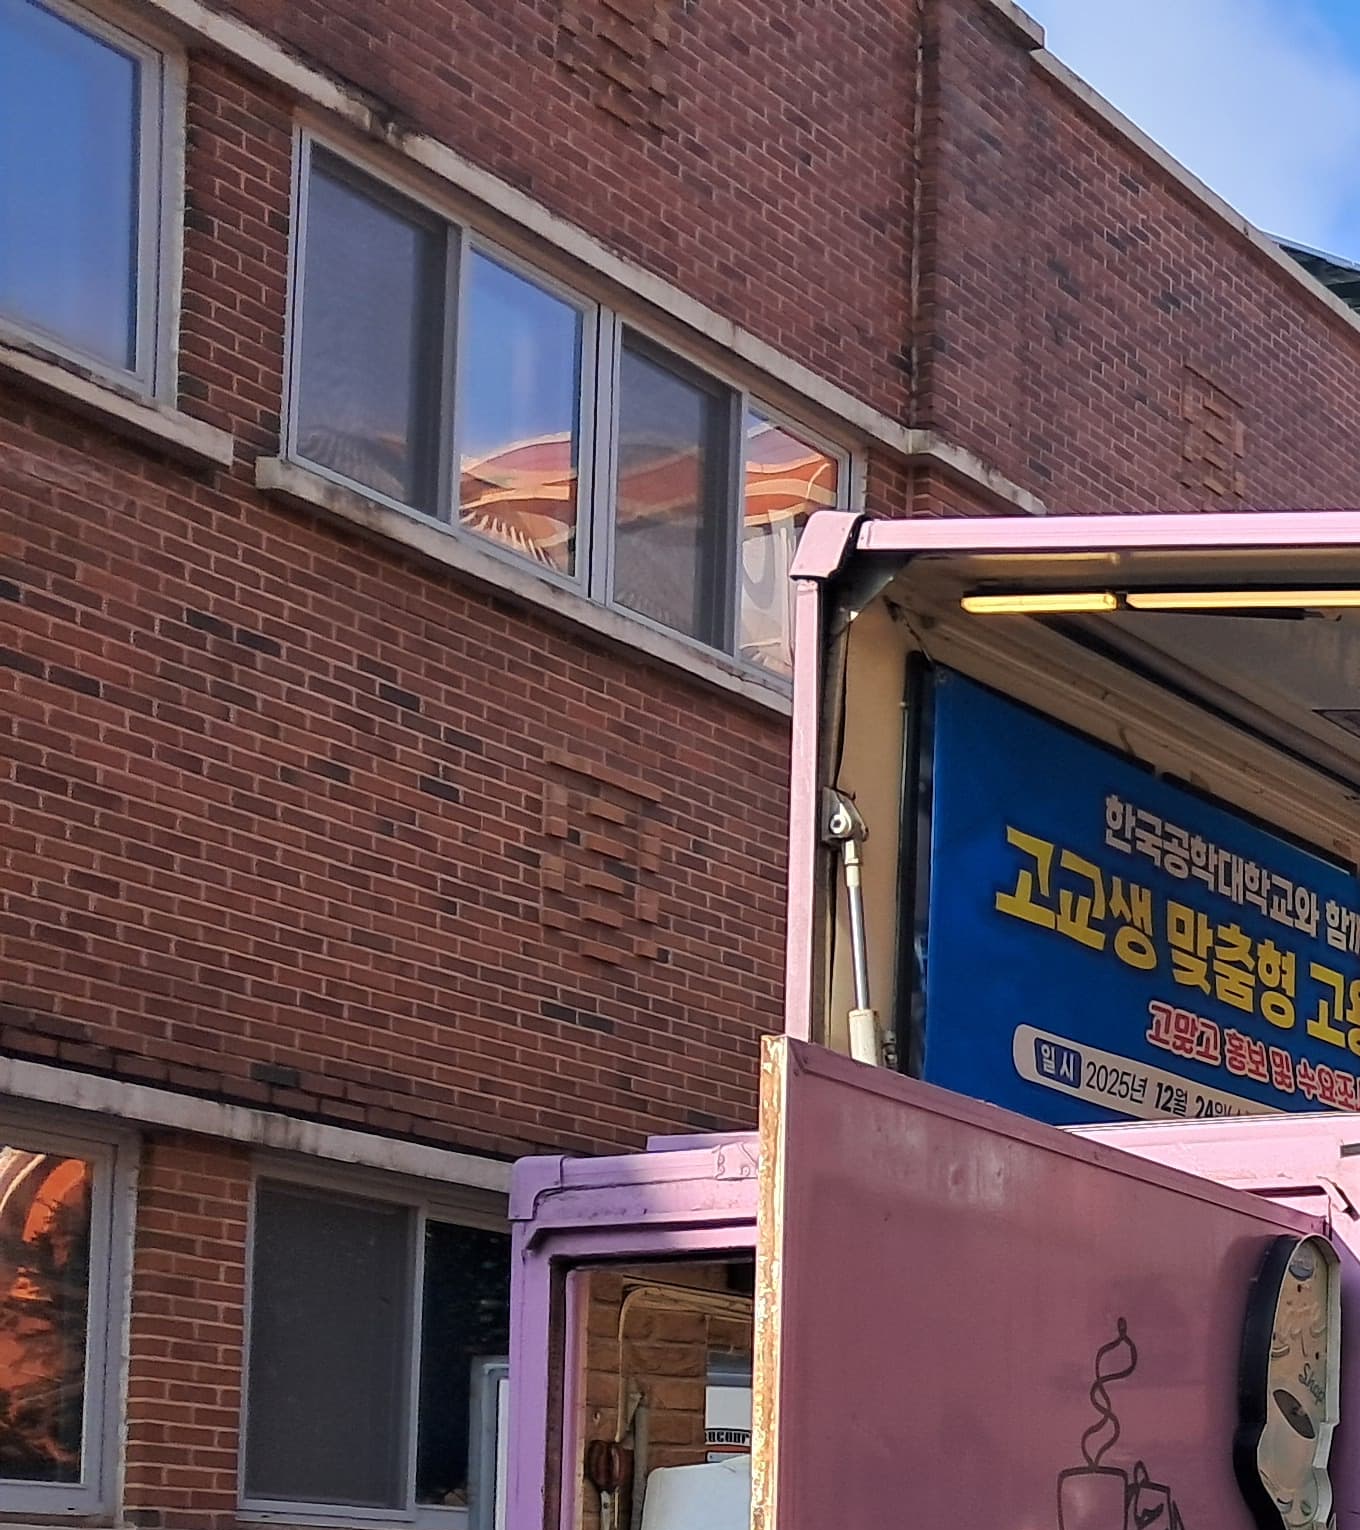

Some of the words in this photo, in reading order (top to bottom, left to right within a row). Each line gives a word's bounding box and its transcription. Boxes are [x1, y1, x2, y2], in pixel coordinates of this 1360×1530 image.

[1104, 794, 1320, 937] 한국공학대학교와
[994, 825, 1158, 970] 고교생
[1166, 901, 1297, 1031] 맞춤형
[1085, 1060, 1149, 1104] 2025년
[1154, 1081, 1189, 1118] 12월
[1223, 1028, 1270, 1083] 홍보
[1269, 1046, 1296, 1093] 및
